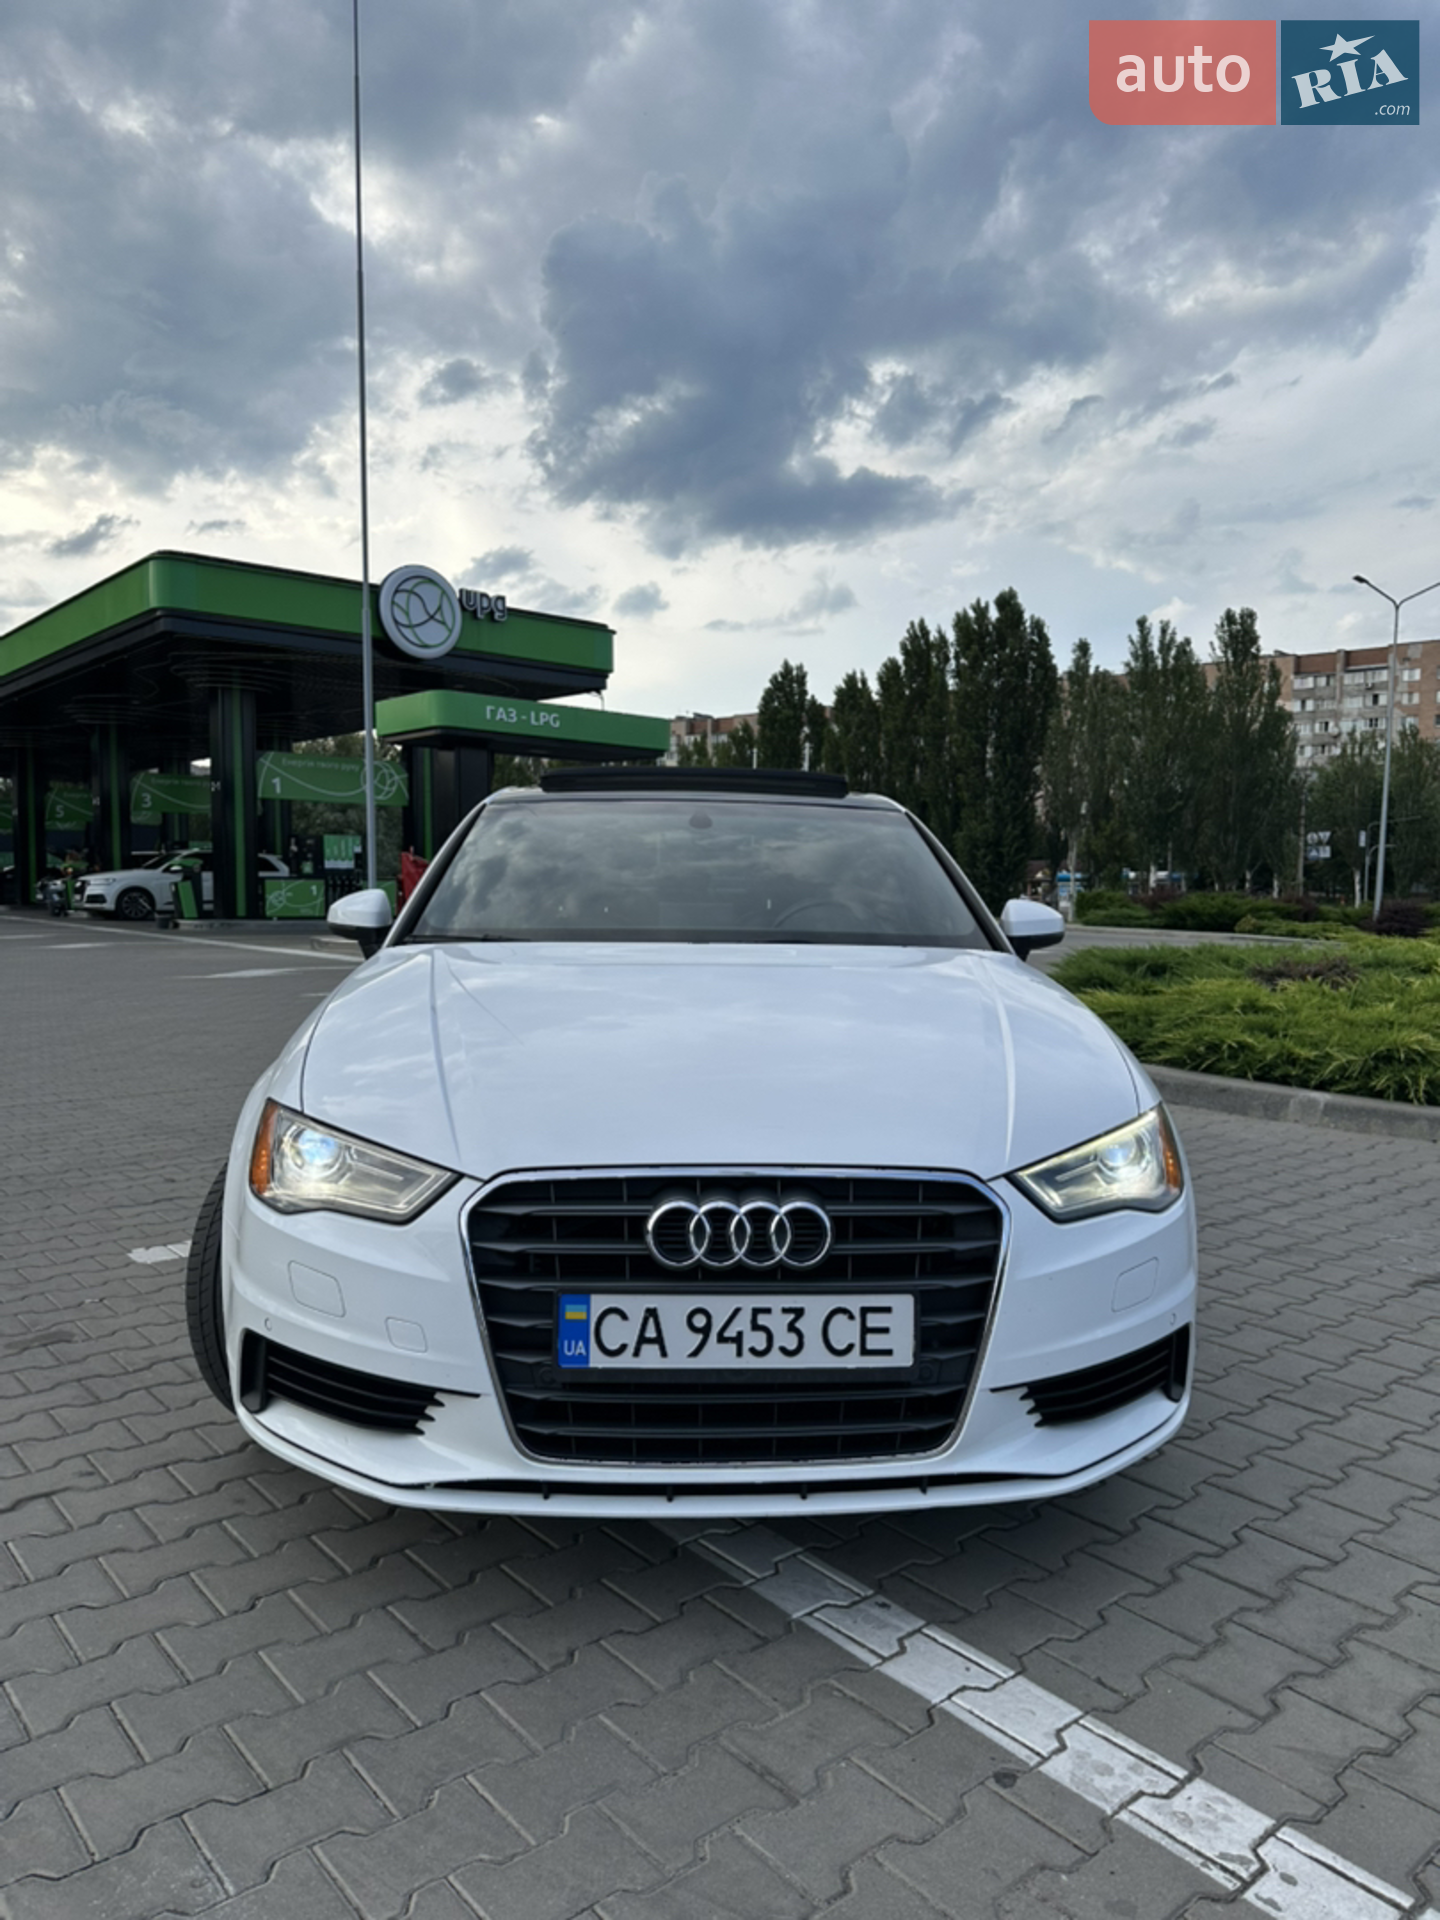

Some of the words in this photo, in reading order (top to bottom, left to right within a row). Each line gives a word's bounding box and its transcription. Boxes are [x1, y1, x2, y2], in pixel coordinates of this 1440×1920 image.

[459, 588, 506, 621] upg
[485, 705, 517, 723] ГАЗ
[530, 711, 560, 728] LPG
[271, 777, 282, 795] 1
[141, 792, 152, 808] 3
[593, 1306, 668, 1358] CA
[685, 1306, 805, 1358] 9453
[821, 1306, 894, 1358] CE
[563, 1339, 587, 1356] UA
